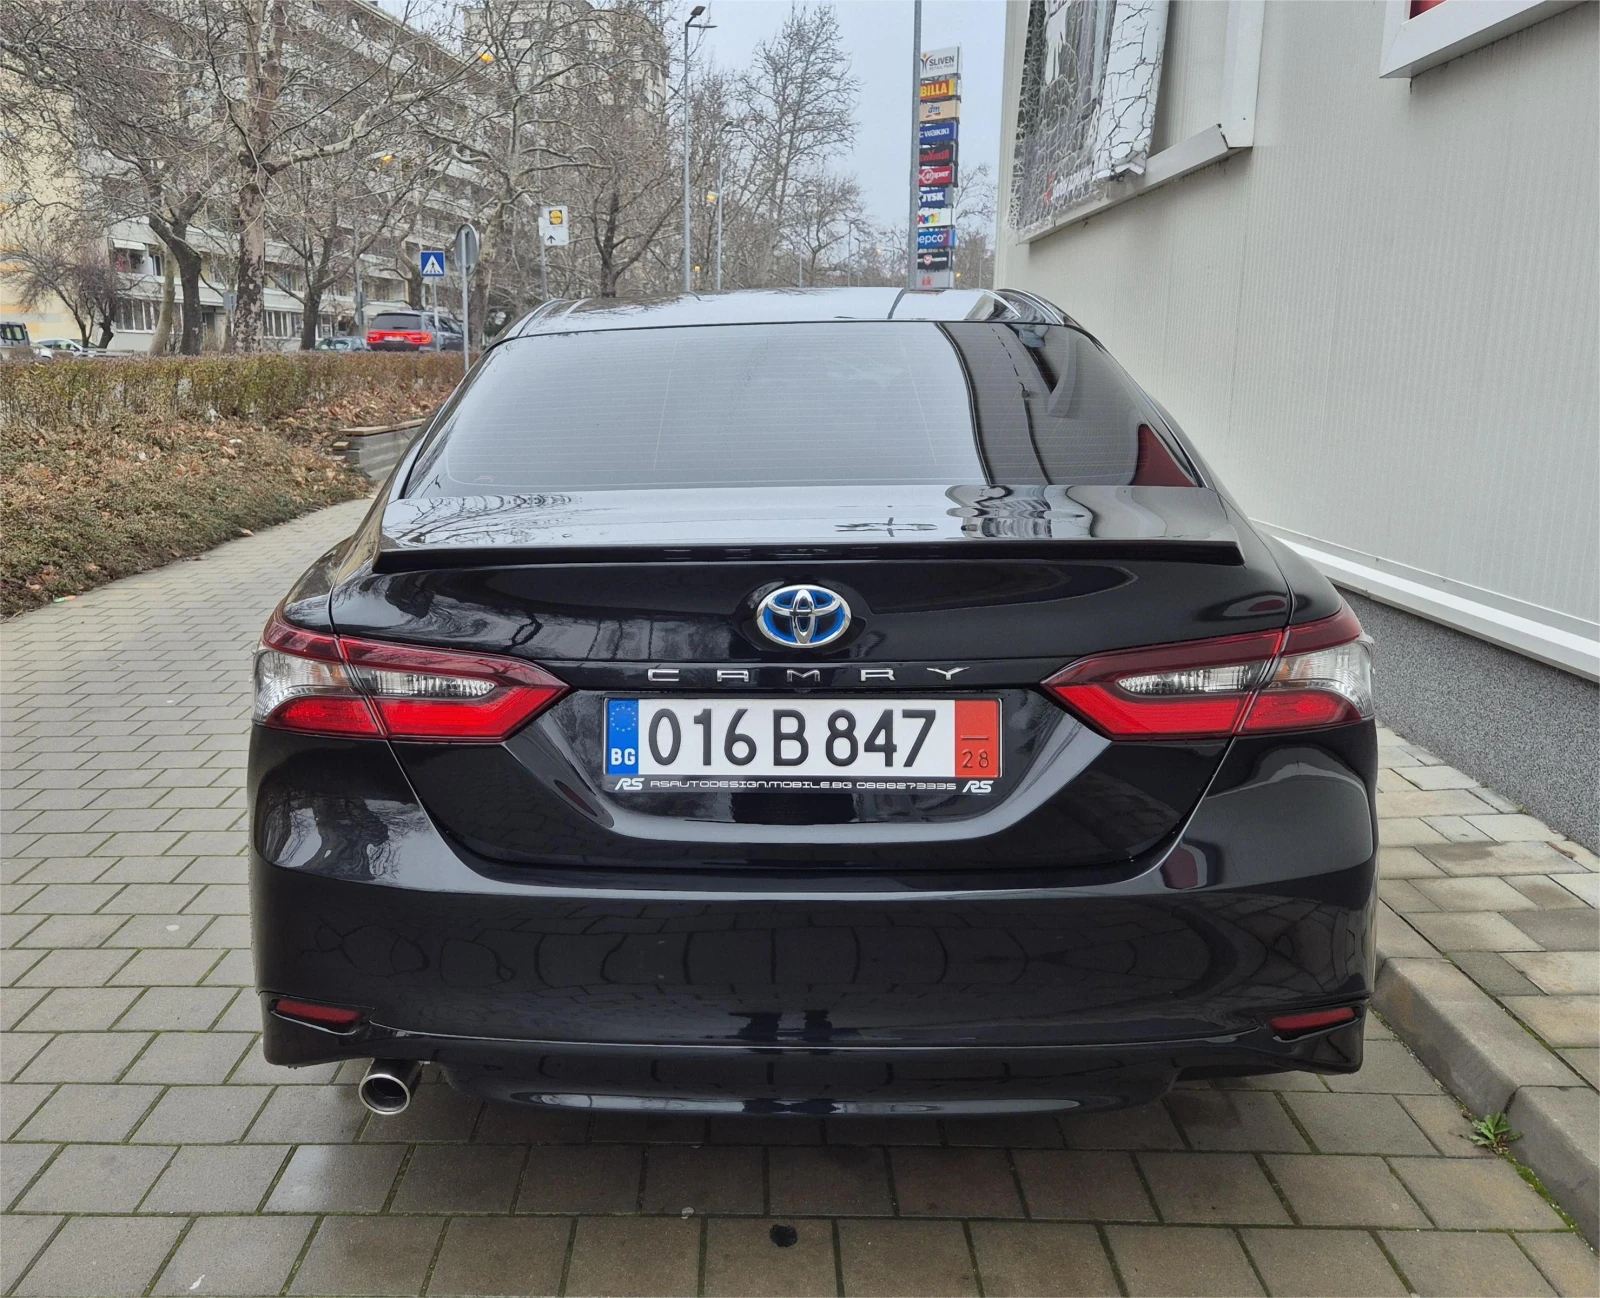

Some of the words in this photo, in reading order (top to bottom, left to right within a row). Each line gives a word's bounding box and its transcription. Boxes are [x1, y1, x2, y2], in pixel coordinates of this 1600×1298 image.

[929, 55, 954, 67] SLIVEN
[920, 82, 948, 97] BILLA
[928, 104, 940, 113] dm
[921, 191, 945, 202] JYSK
[918, 234, 944, 245] epco
[647, 666, 970, 683] CAMRY
[648, 708, 757, 767] 016
[772, 709, 809, 767] B
[825, 708, 937, 768] 847
[610, 747, 636, 766] BG
[962, 749, 990, 770] 28
[614, 777, 646, 791] RS
[962, 780, 994, 793] RS
